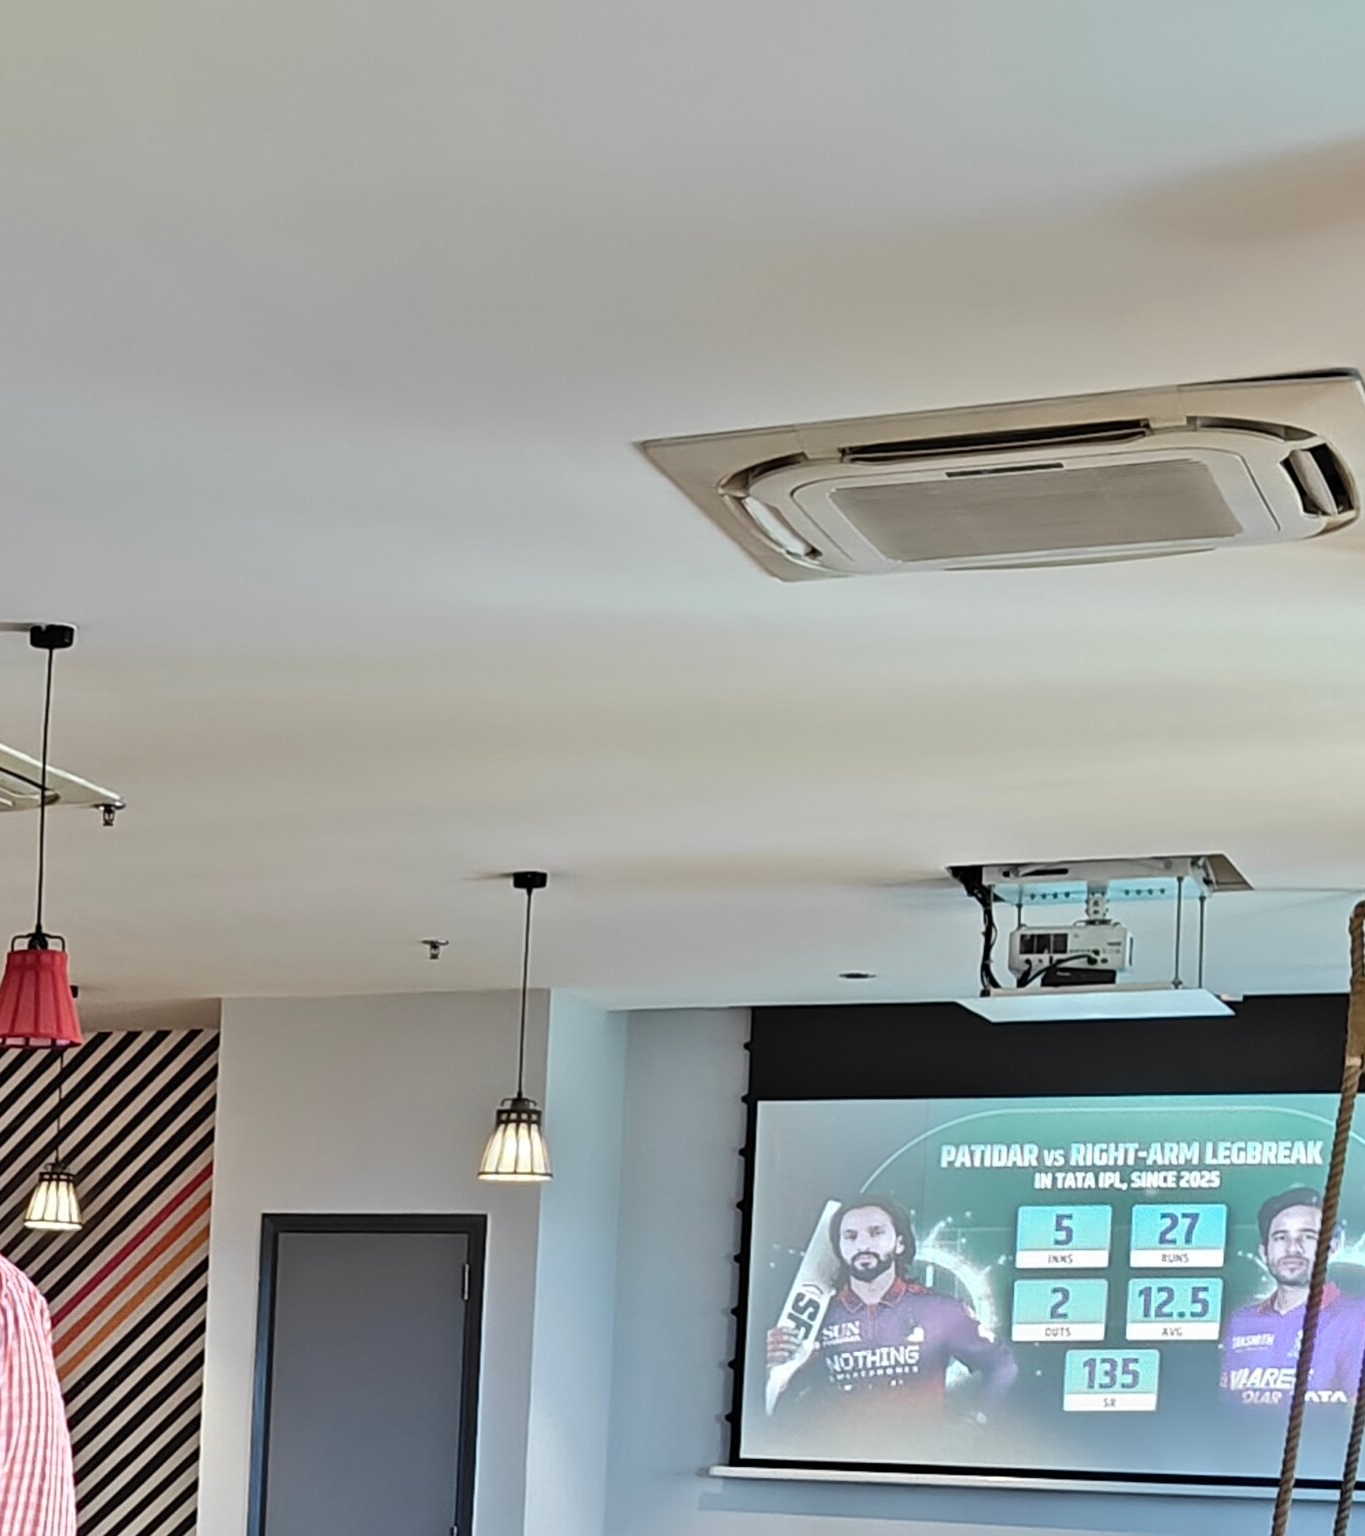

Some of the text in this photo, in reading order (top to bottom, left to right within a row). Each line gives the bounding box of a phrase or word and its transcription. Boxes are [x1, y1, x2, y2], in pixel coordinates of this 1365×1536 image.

[940, 1144, 1039, 1168] PATIDAR
[1070, 1142, 1199, 1167] RIGHT-ARM
[1205, 1140, 1324, 1166] LEGBREAK
[1034, 1170, 1221, 1191] IN TATA IPL, SINCE 2025
[1052, 1213, 1074, 1246] 5
[1158, 1212, 1201, 1246] 27
[1161, 1253, 1190, 1264] RUNS
[1050, 1287, 1071, 1320] 2
[1138, 1286, 1210, 1319] 12.5
[822, 1321, 861, 1342] SUN
[1044, 1327, 1072, 1338] OUTS
[1161, 1327, 1184, 1337] AVG
[825, 1345, 920, 1372] NOTHING
[1082, 1358, 1141, 1390] 135
